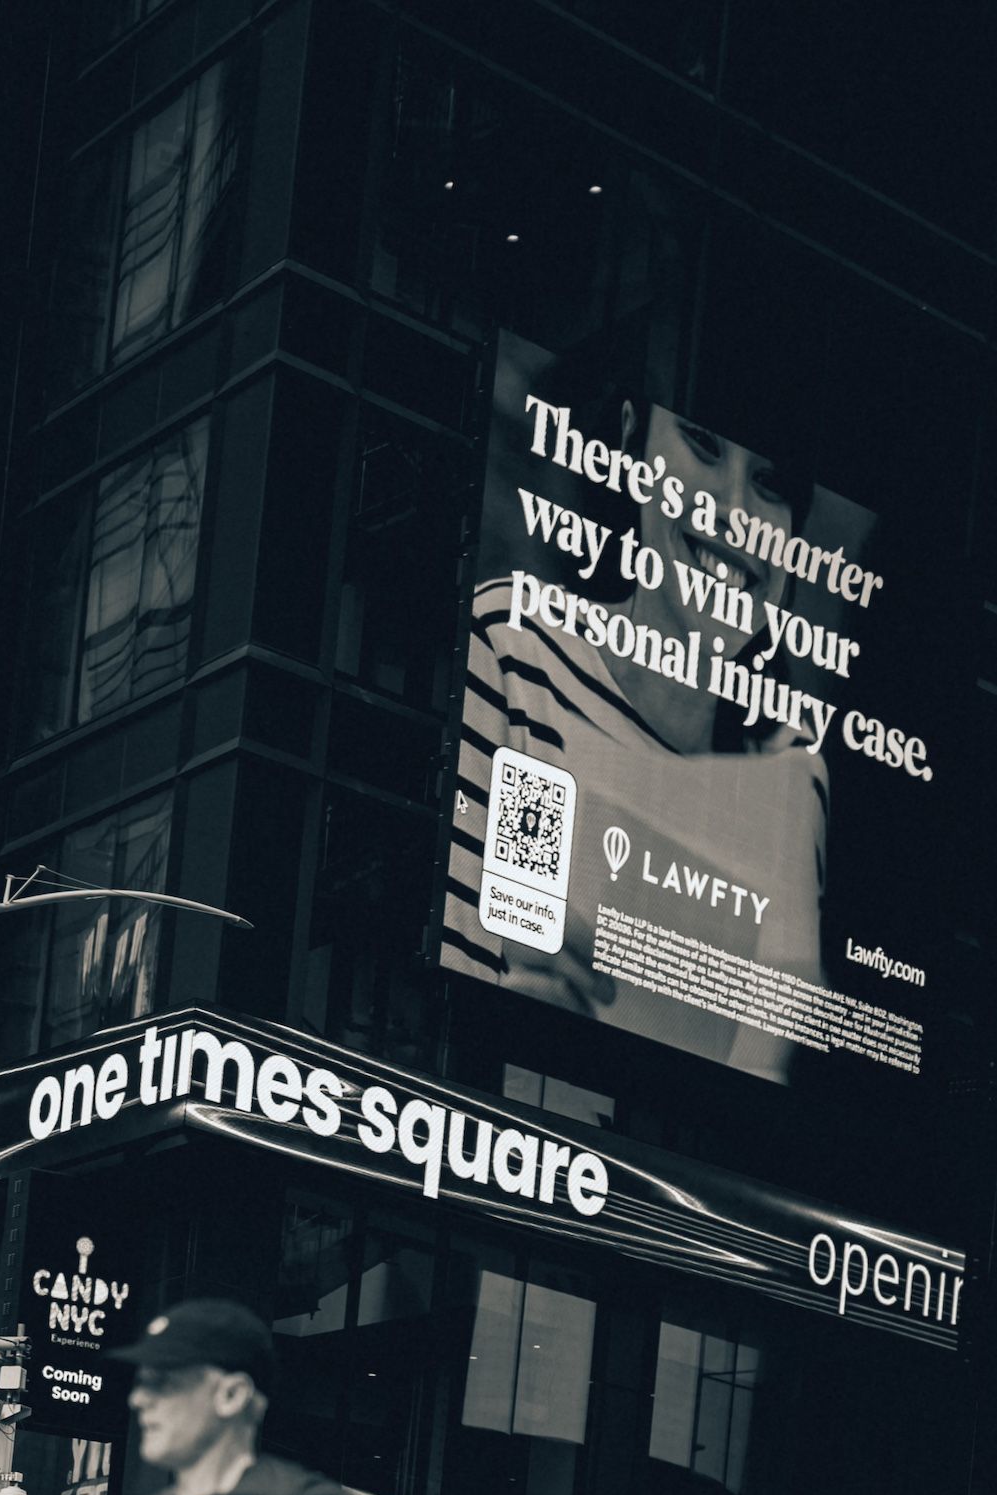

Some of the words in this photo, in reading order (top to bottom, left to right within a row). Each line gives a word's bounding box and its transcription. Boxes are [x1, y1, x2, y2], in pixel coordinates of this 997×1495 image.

[525, 394, 684, 519] There's
[692, 490, 717, 537] a
[725, 508, 883, 608] smarter
[518, 488, 612, 579] way
[620, 527, 664, 590] to
[673, 560, 753, 634] win
[760, 601, 860, 678] your
[507, 571, 701, 689] personal
[708, 637, 837, 754] injury
[843, 711, 933, 781] case.
[490, 886, 514, 906] Save
[516, 898, 533, 912] our
[535, 901, 556, 924] info,
[643, 851, 770, 925] LAWFTY
[487, 903, 506, 921] just
[508, 910, 518, 926] in
[520, 918, 544, 935] case.
[846, 937, 926, 987] Lawfty.com
[29, 1053, 128, 1140] one
[140, 1026, 343, 1136] times
[357, 1086, 609, 1216] square
[33, 1269, 129, 1309] CANDY
[49, 1301, 106, 1336] NYC
[50, 1333, 101, 1350] Experience
[42, 1365, 103, 1392] Coming
[52, 1385, 90, 1404] Soon
